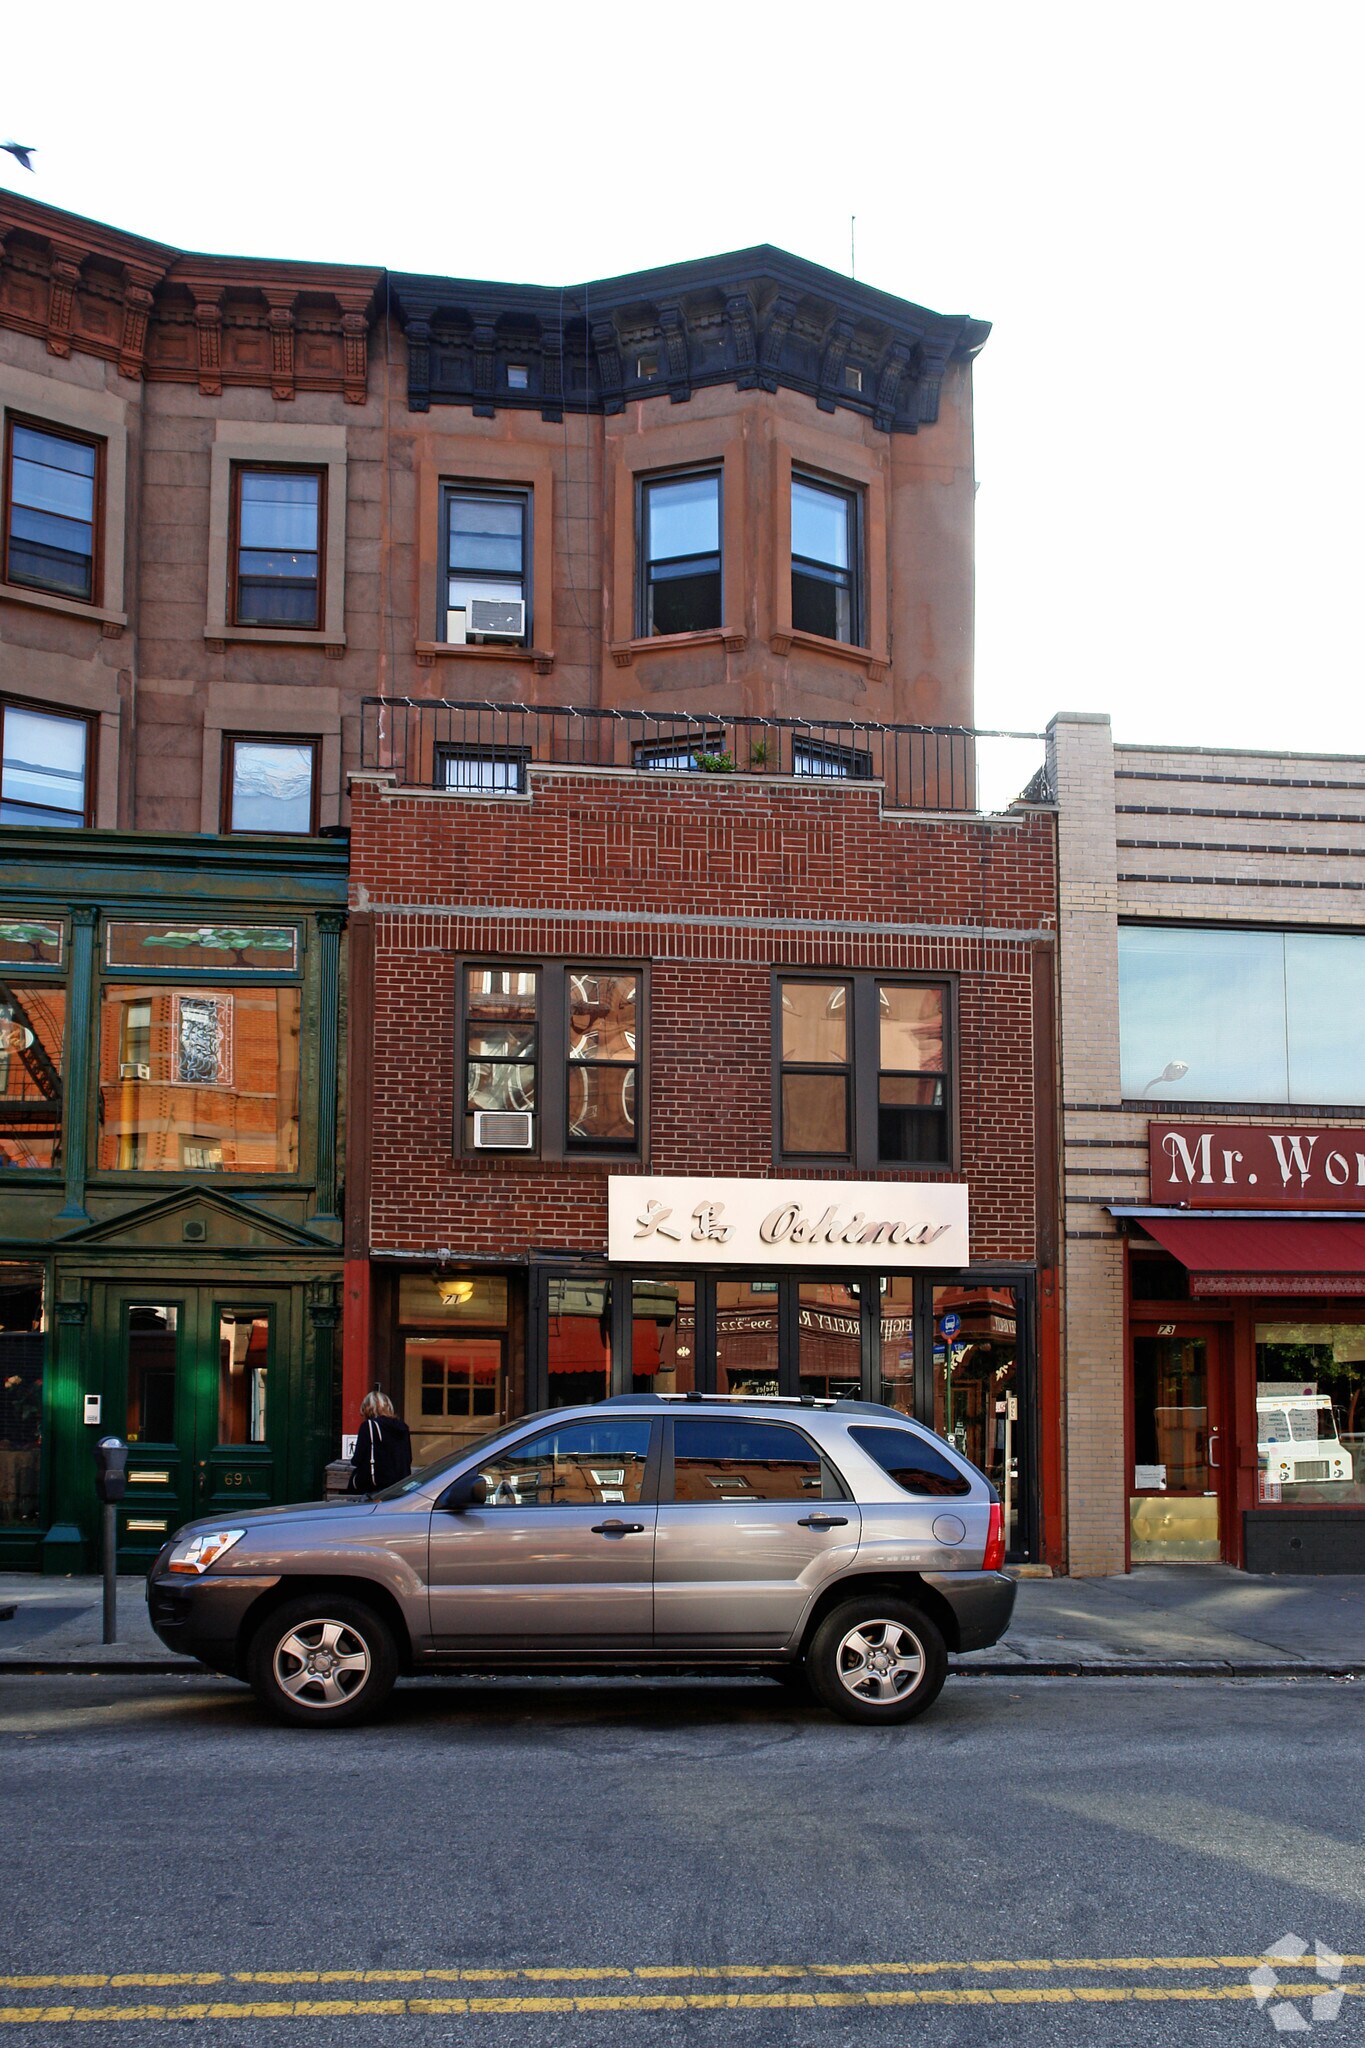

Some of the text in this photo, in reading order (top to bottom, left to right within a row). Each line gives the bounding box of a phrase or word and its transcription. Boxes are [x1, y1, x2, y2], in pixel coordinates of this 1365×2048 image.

[1162, 1132, 1258, 1185] Mr.
[760, 1200, 952, 1246] Oshima
[445, 1295, 459, 1304] 71
[1159, 1325, 1174, 1335] 73
